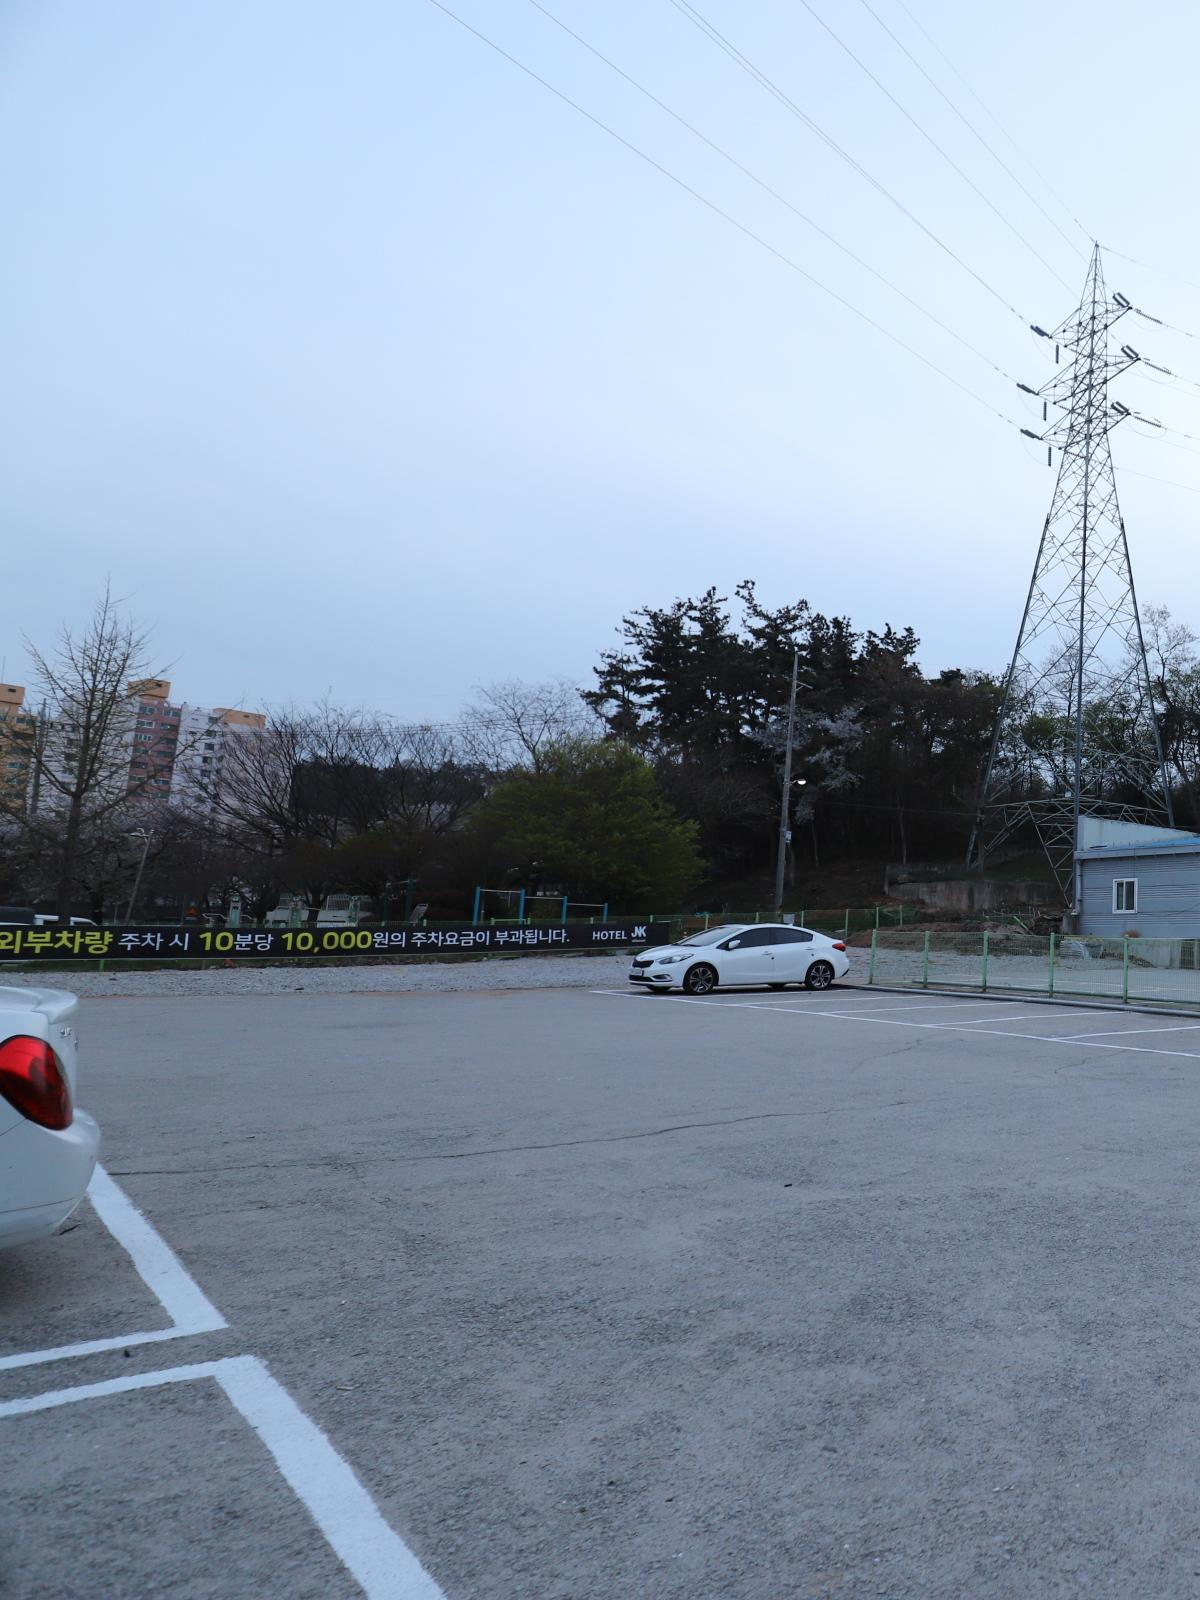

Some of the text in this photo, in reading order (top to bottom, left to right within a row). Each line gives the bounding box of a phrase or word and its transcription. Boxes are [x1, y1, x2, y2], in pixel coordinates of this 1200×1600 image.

[0, 929, 570, 954] 외부차량 주차 시 10분당 10,000원의 주차요금이 부과됩니다.
[592, 931, 627, 940] HOTEL
